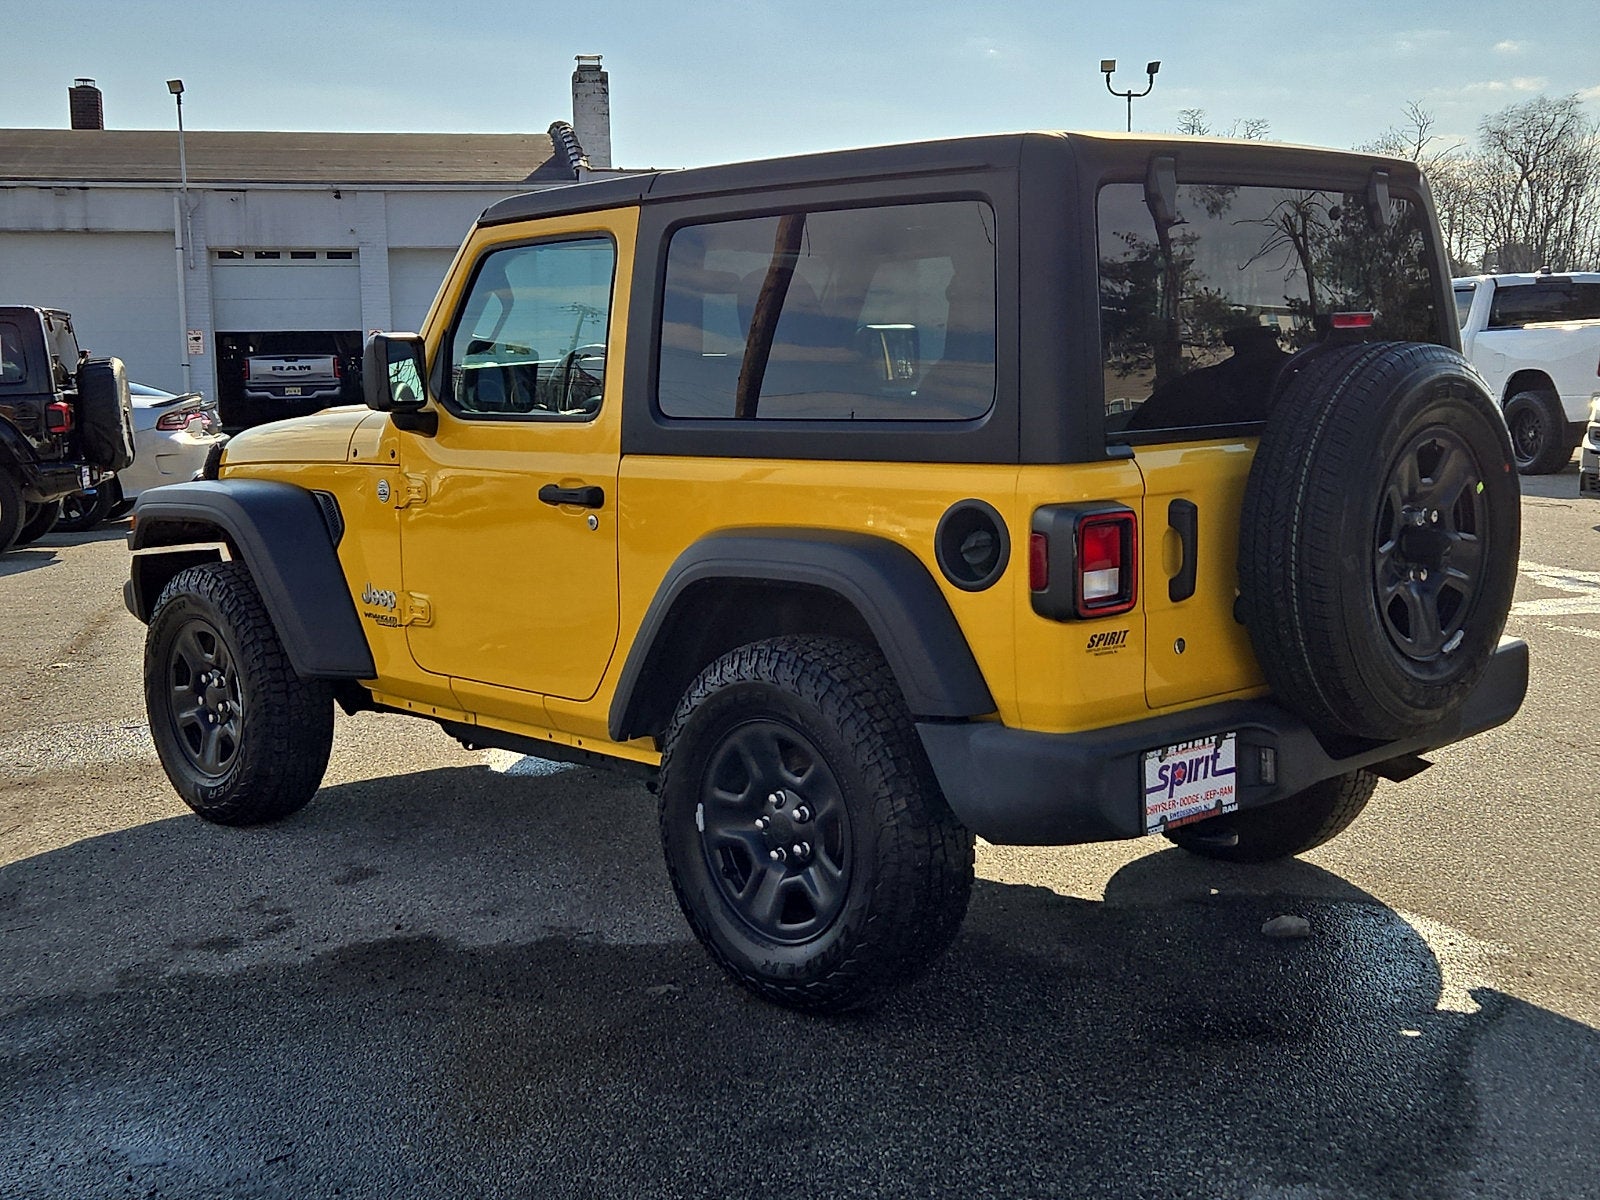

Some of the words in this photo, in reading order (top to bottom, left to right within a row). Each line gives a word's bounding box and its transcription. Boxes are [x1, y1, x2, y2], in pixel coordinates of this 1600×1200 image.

[362, 582, 396, 612] Jeep
[1087, 630, 1129, 648] SPIRIT
[1167, 735, 1218, 752] SPIRIT
[1146, 747, 1236, 799] spirit
[1146, 799, 1176, 816] CHRYSLER
[1180, 793, 1200, 807] DODGE
[1202, 788, 1217, 801] JEEP
[1219, 785, 1233, 797] RAM
[1221, 803, 1239, 814] RAM
